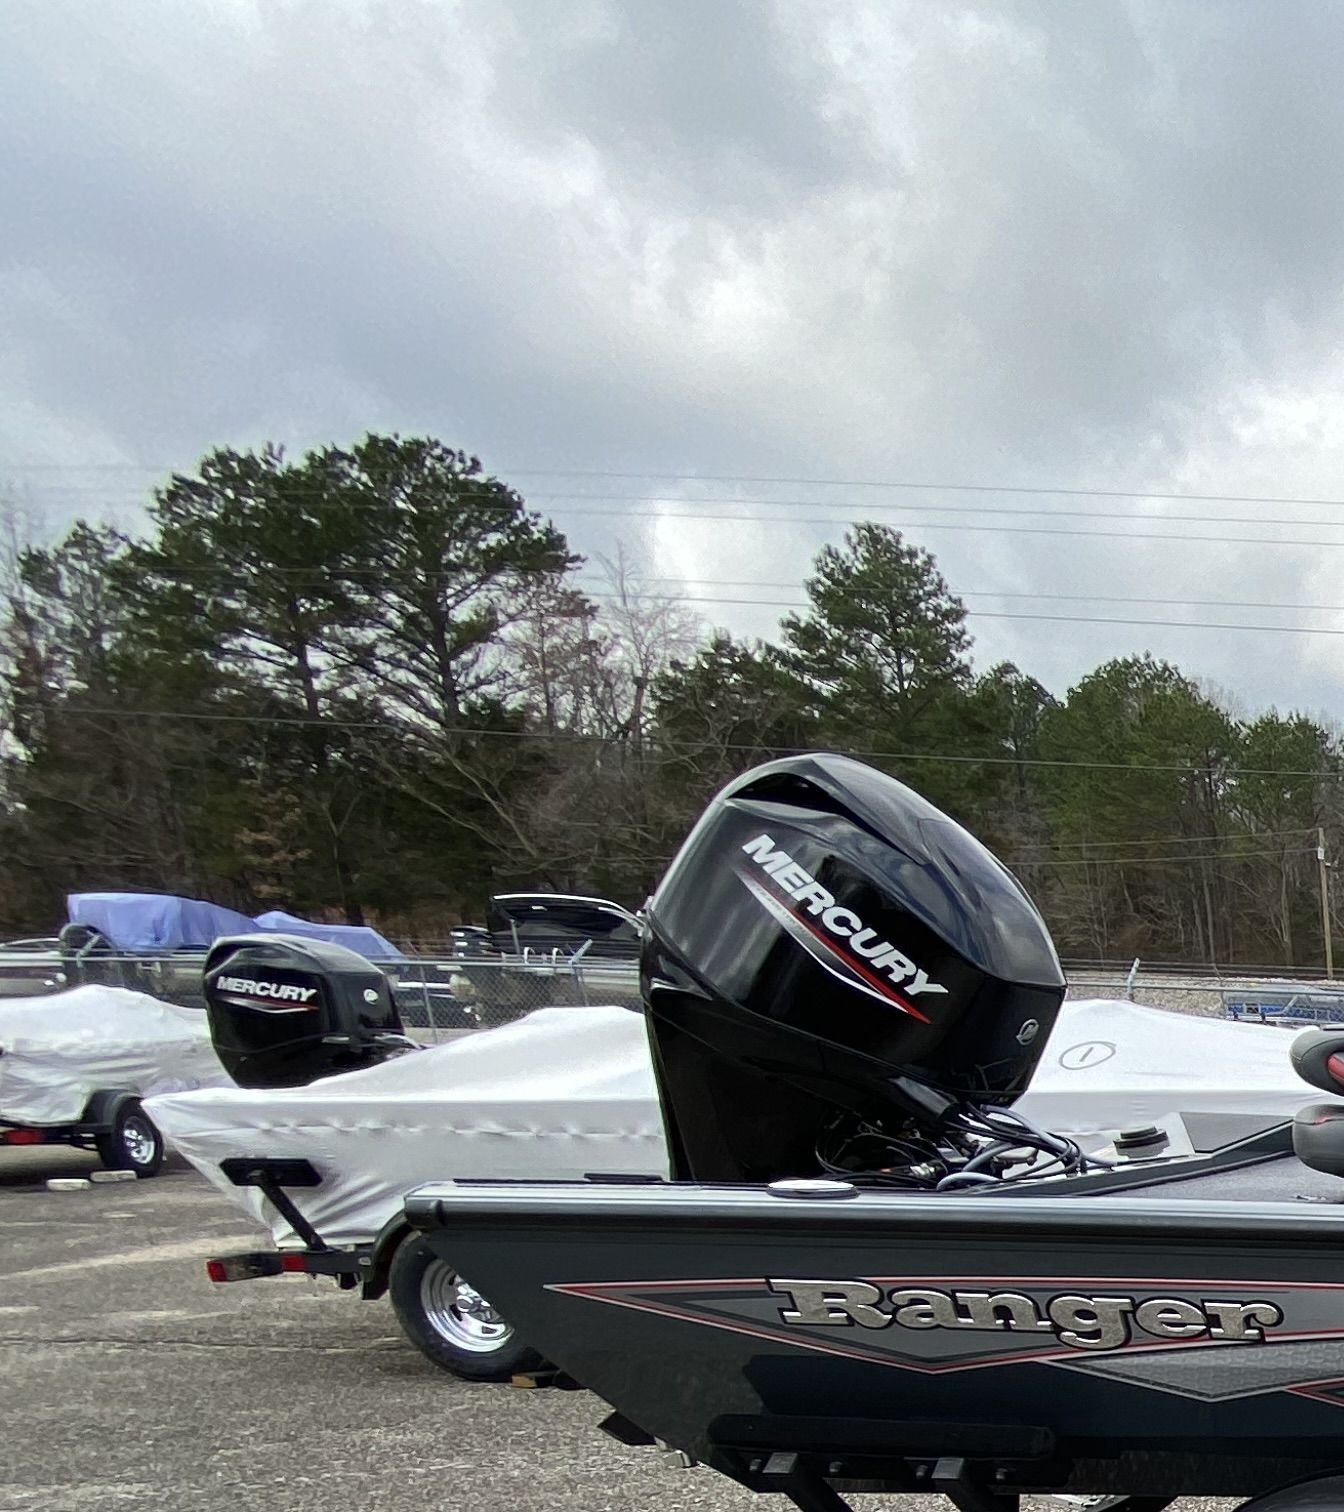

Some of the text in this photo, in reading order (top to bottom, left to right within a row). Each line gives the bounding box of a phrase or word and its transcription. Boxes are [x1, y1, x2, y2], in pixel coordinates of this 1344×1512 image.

[742, 834, 949, 995] MERCURY
[217, 976, 317, 1002] MERCURY
[766, 1277, 1284, 1350] Ranger
